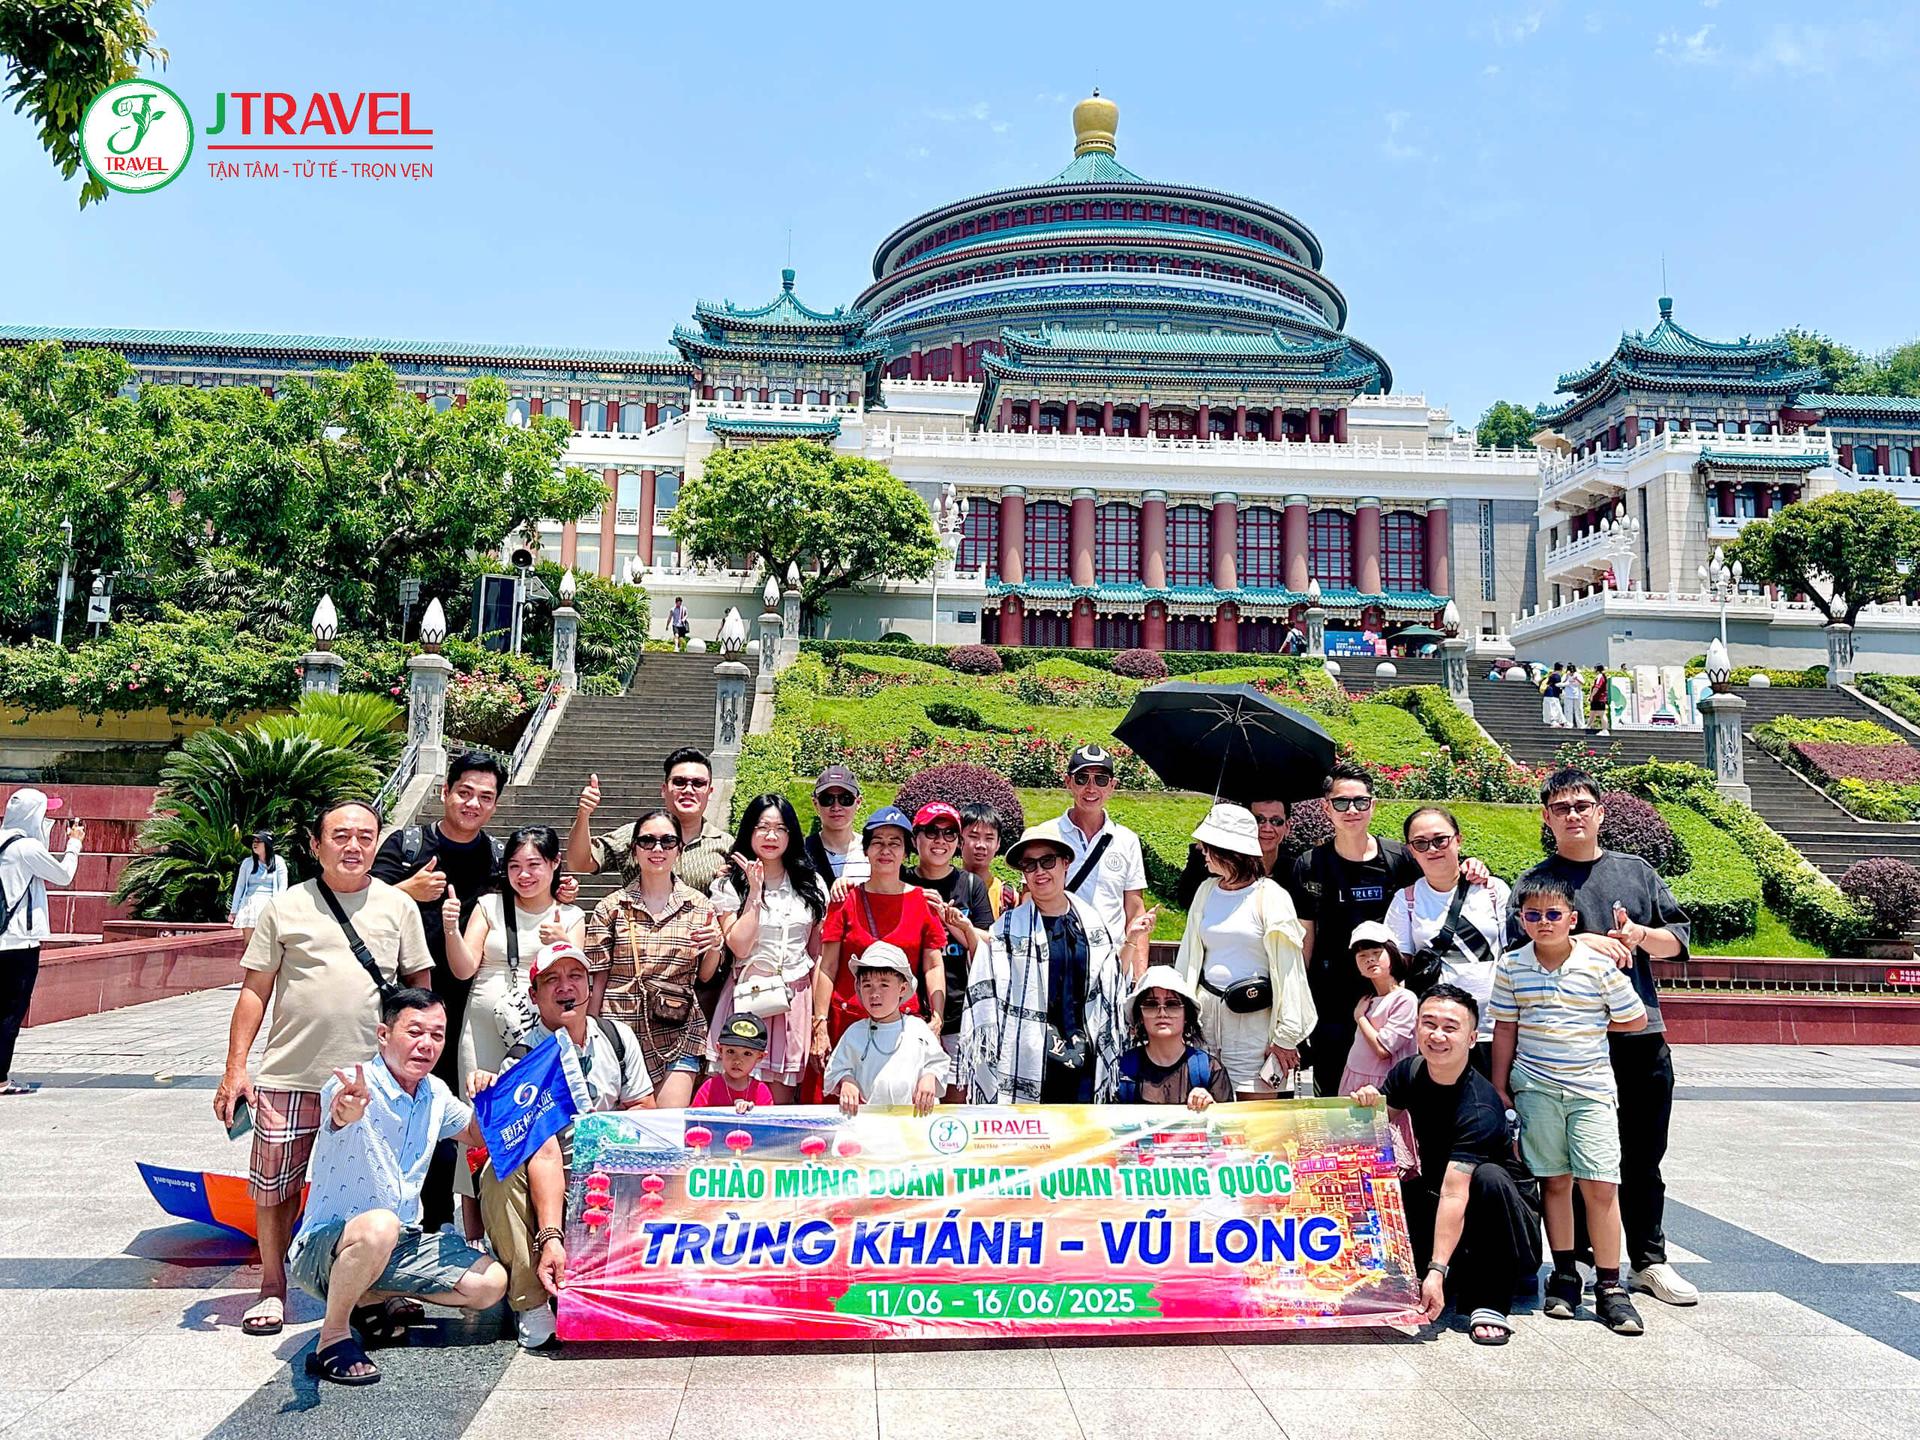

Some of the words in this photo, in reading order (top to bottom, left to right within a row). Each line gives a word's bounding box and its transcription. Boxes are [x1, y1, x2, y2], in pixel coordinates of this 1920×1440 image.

[972, 1119, 1049, 1135] JTRAVEL
[153, 1175, 197, 1193] Sacombank
[689, 1162, 765, 1199] CHÀO
[774, 1162, 860, 1199] MỪNG
[1040, 1167, 1112, 1200] QUAN
[1119, 1166, 1211, 1197] TRUNG
[1217, 1154, 1293, 1200] QUỐC
[642, 1212, 837, 1266] TRÙNG
[851, 1209, 1044, 1266] KHÁNH
[1060, 1240, 1085, 1252] -
[1101, 1208, 1172, 1265] VŨ
[1188, 1216, 1342, 1264] LONG
[865, 1286, 943, 1317] 11/06
[972, 1286, 1136, 1317] 16/06/2025
